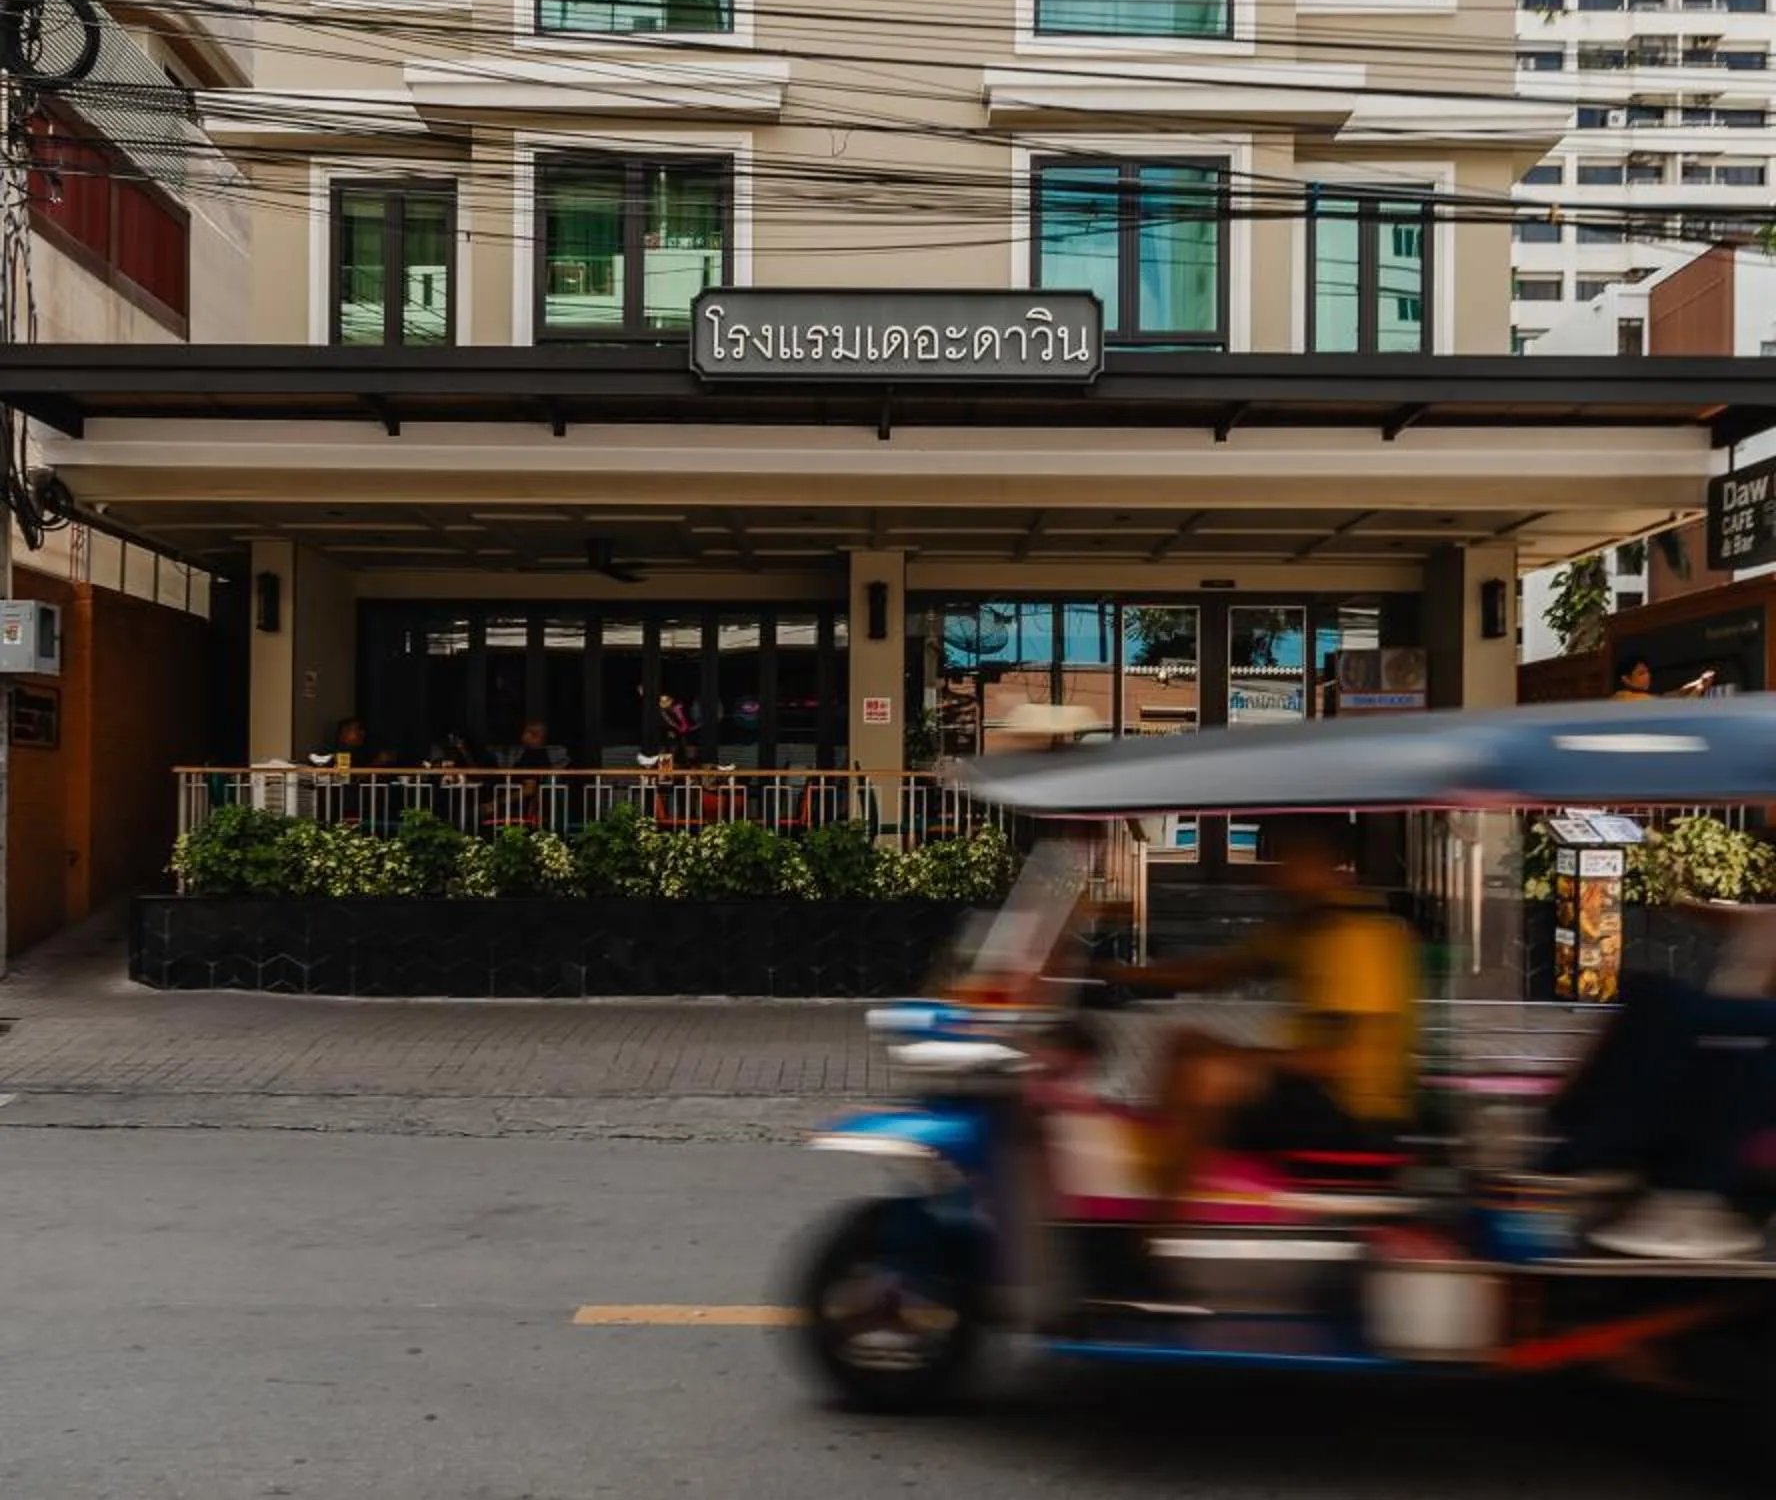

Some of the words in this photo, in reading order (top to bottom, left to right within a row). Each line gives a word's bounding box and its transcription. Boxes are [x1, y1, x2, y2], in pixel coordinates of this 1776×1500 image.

[705, 305, 1090, 361] โรงแรมเดอะดาวิน
[1721, 507, 1755, 536] CAFE
